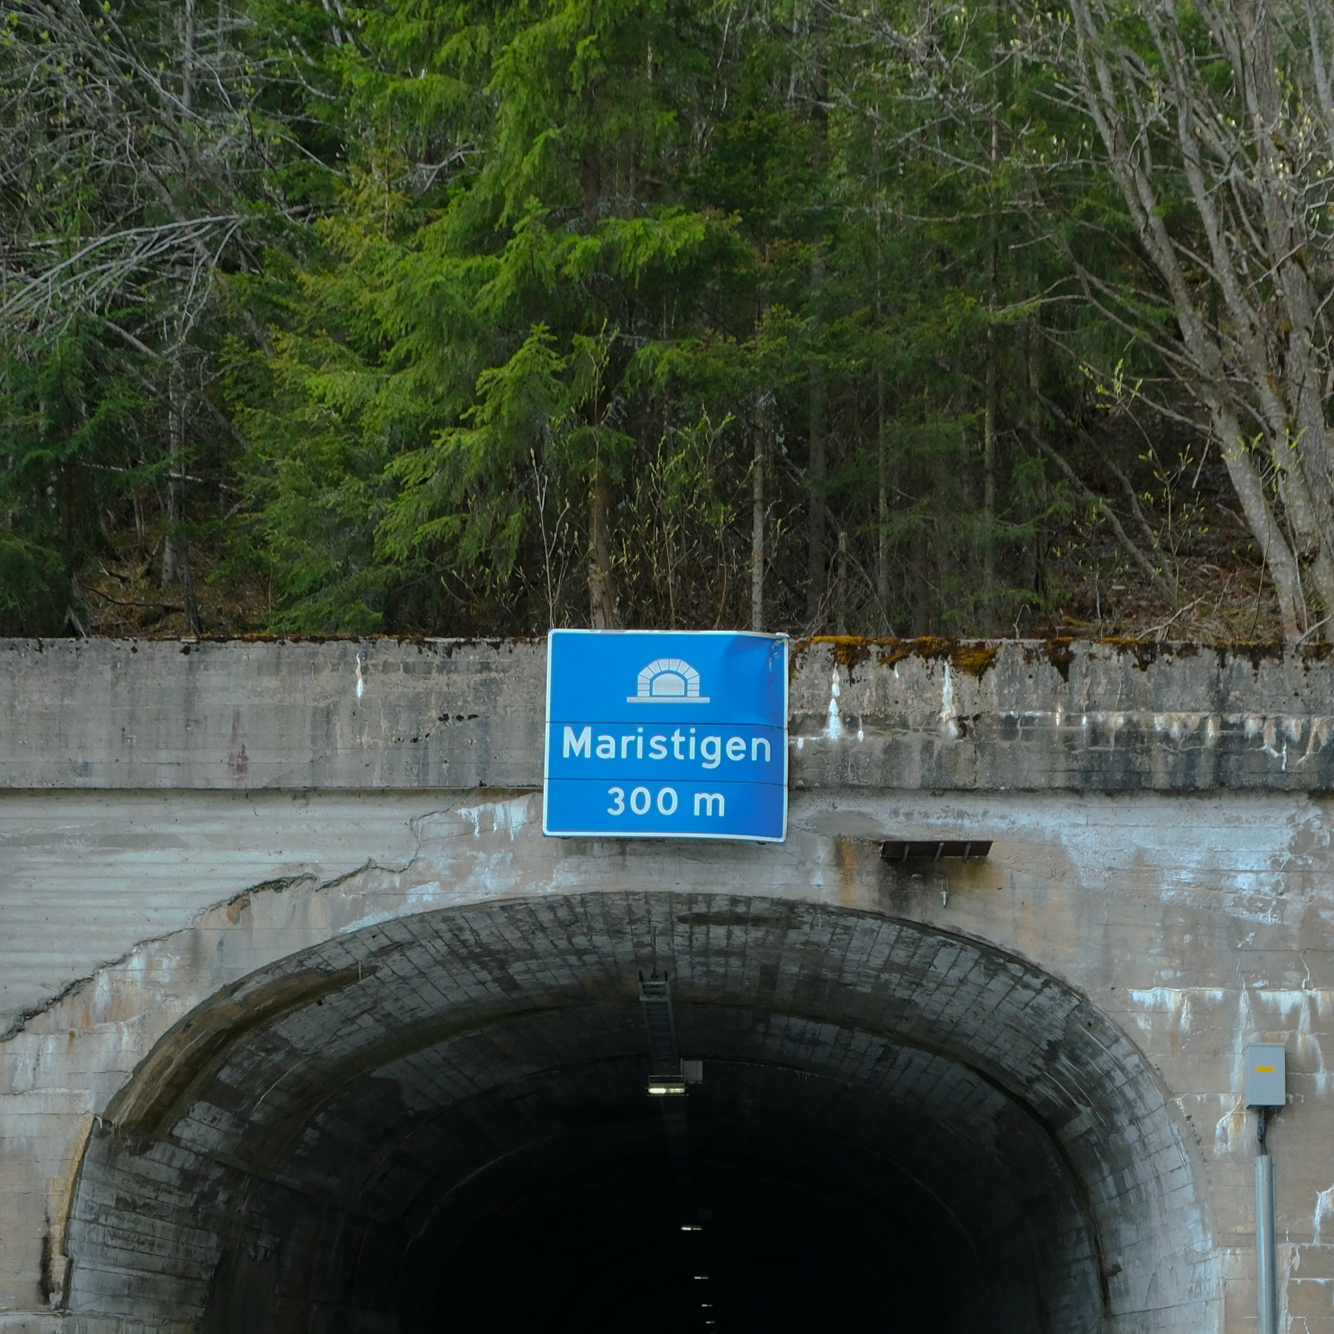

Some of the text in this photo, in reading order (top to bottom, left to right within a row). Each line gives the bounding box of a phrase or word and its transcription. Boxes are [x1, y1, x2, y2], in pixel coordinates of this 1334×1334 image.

[562, 726, 772, 770] Maristigen
[606, 786, 725, 817] 300 m
